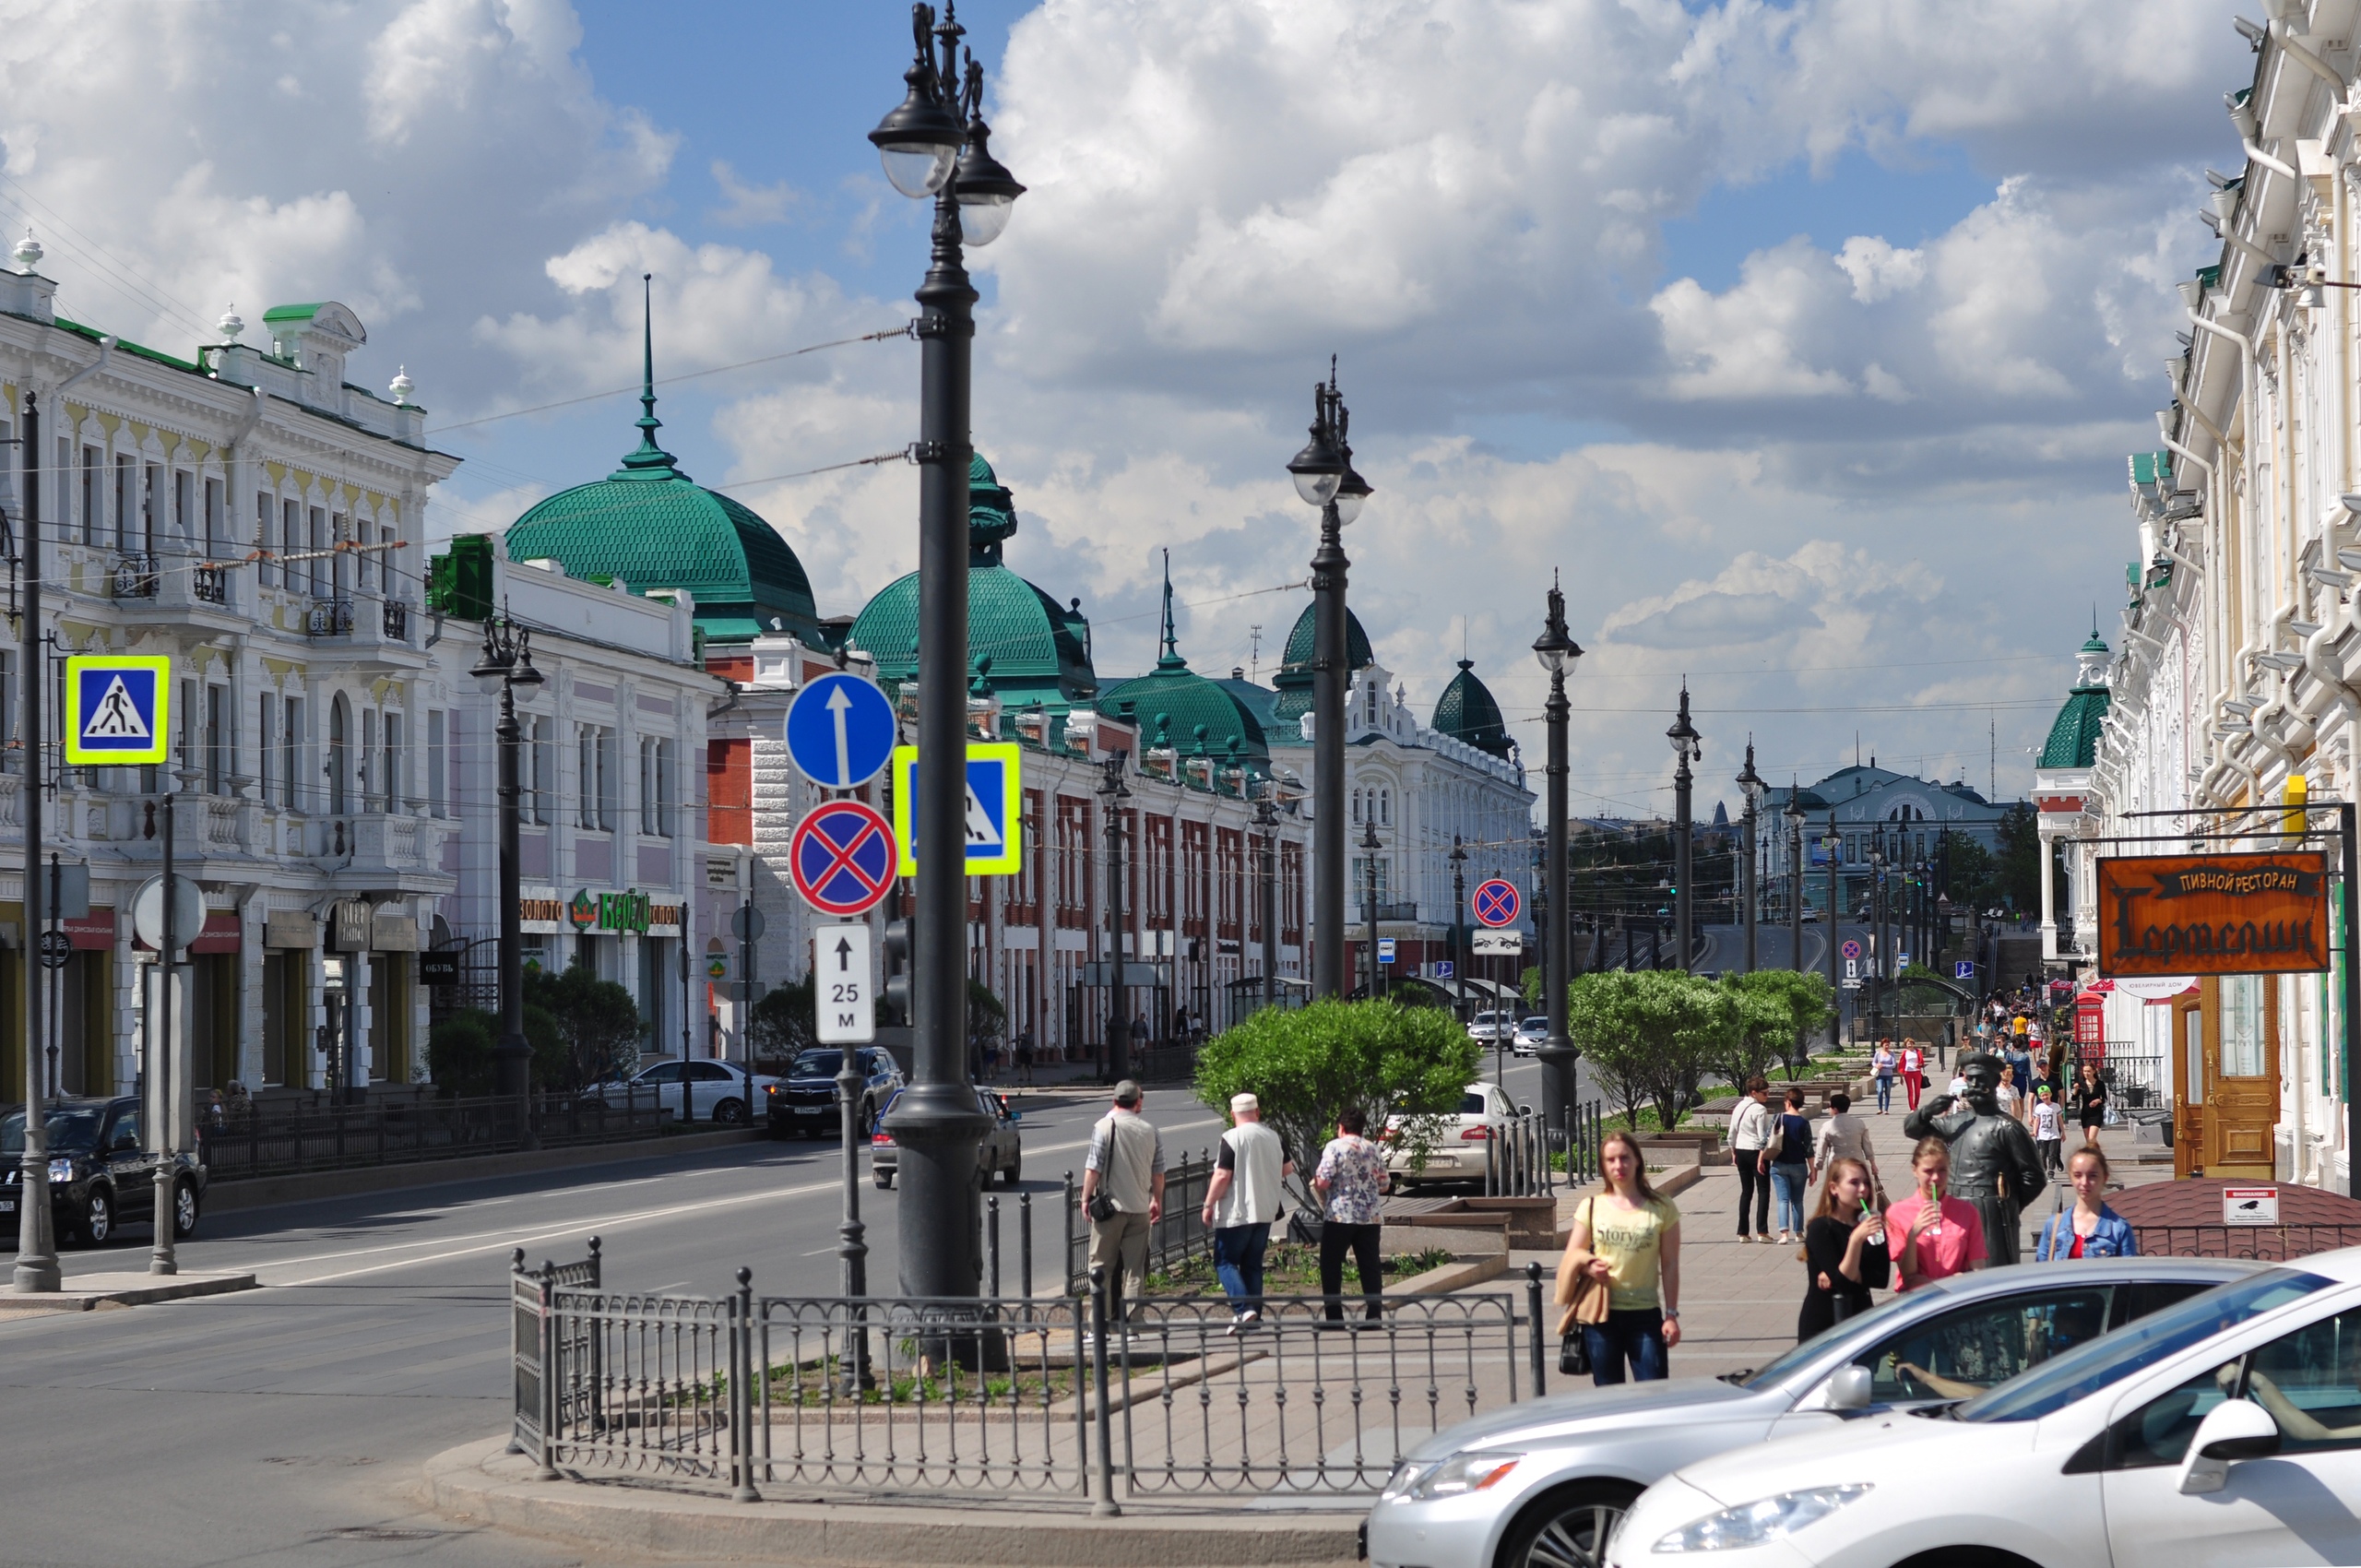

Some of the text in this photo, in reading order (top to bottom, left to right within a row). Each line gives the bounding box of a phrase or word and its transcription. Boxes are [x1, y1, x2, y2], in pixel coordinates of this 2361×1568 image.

[2179, 872, 2297, 893] ПИВНОЙ РЕСТОРАН
[519, 899, 563, 921] ЗОЛОТО
[649, 906, 678, 924] ОЛОТ
[425, 964, 454, 972] ОБУВЬ
[832, 983, 859, 1003] 25
[2041, 1113, 2053, 1129] 23
[1596, 1226, 1637, 1246] Story
